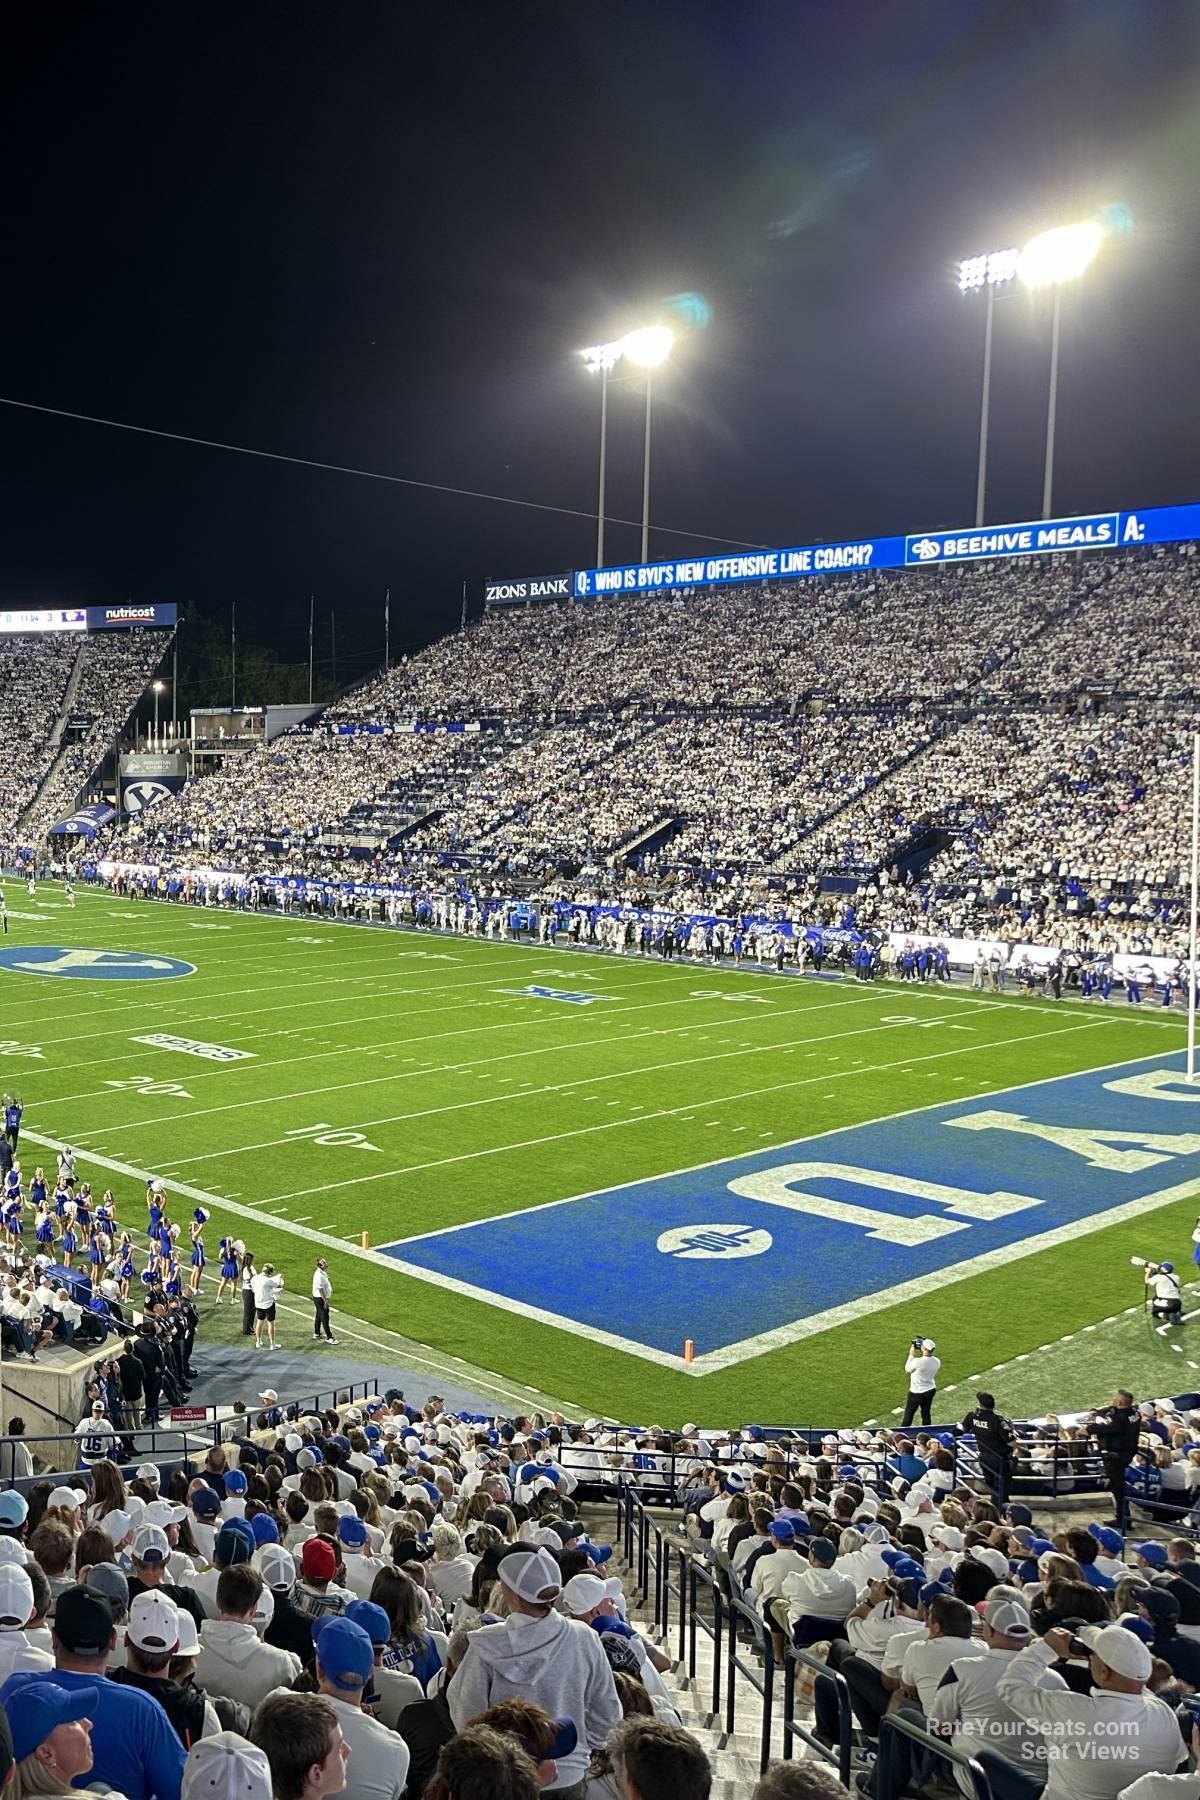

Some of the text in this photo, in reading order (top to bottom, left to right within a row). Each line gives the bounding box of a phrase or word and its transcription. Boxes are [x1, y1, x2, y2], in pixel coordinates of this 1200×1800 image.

[943, 522, 1112, 556] BEEHIVE MEALS
[1123, 515, 1145, 542] A:
[577, 544, 873, 593] Q: WHO IS BYU'S NEW OFFENSIVE LINE COACH?
[486, 578, 569, 601] ZIONS BANK
[105, 607, 155, 619] nutricost
[354, 886, 412, 898] BYU COUGA
[619, 910, 638, 921] GO
[162, 1037, 245, 1061] PACS
[104, 1076, 185, 1096] 20
[284, 1123, 367, 1146] 10
[972, 1418, 989, 1430] POLICE
[86, 1436, 102, 1452] 16
